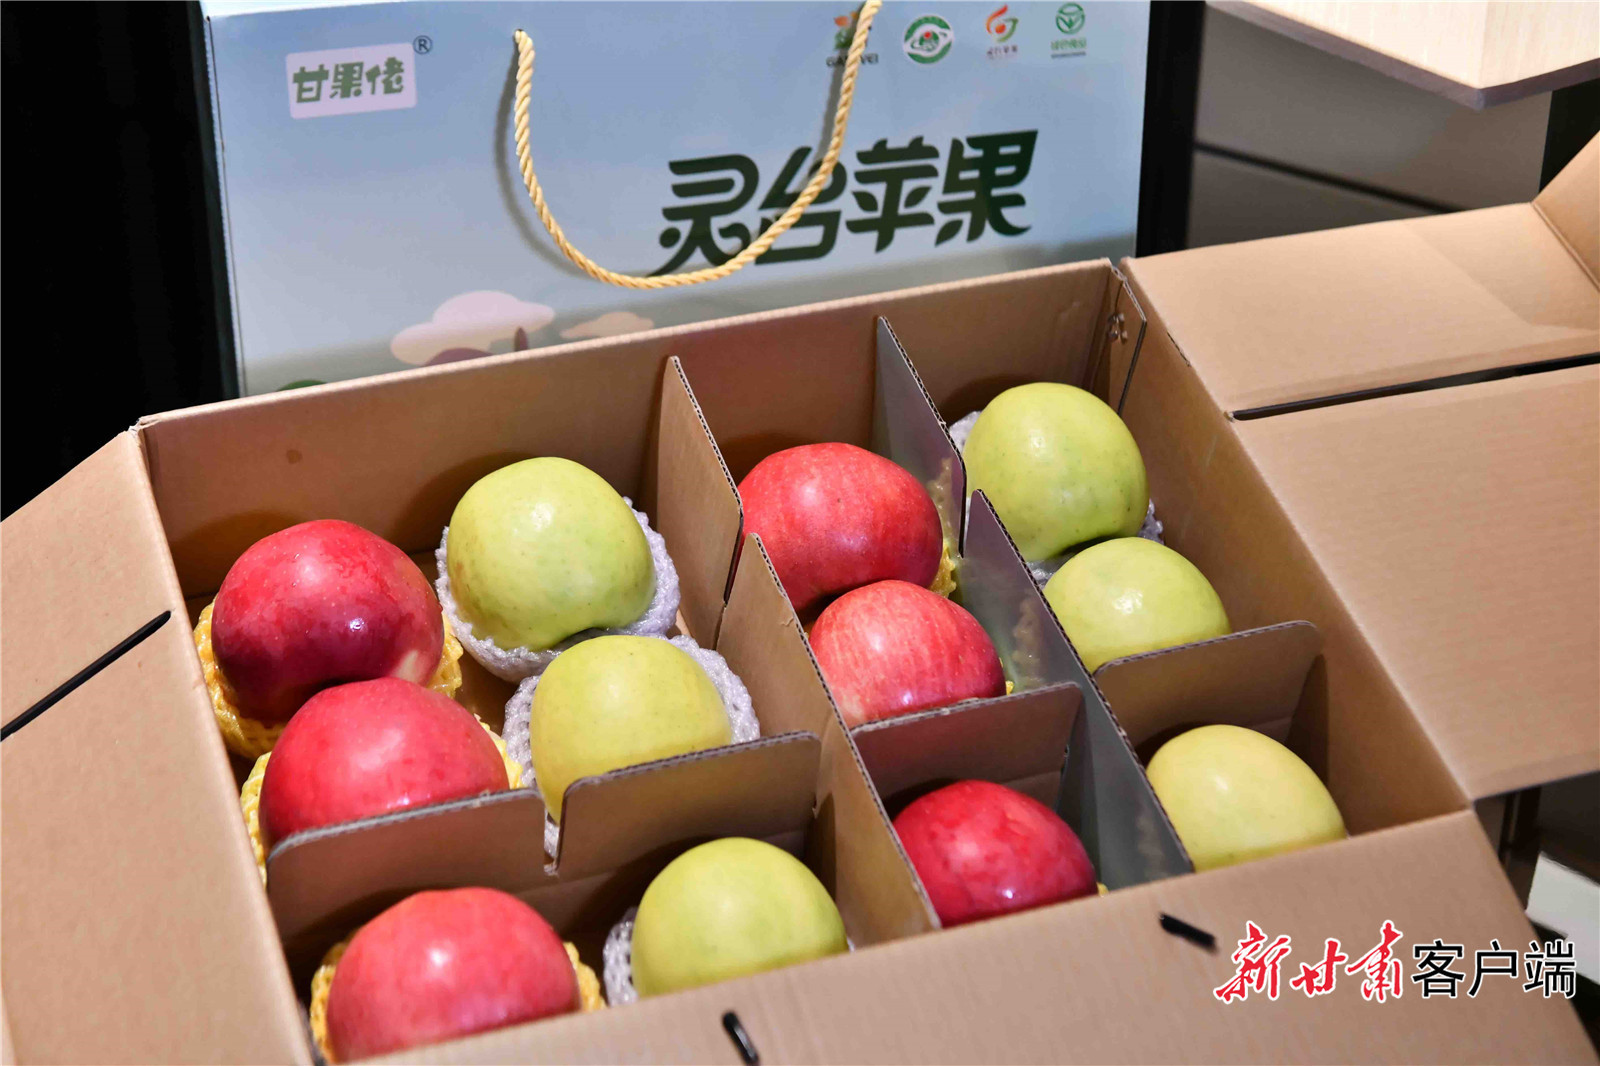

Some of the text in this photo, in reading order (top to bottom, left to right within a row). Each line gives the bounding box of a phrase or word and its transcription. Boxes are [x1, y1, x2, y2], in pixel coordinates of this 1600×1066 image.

[292, 56, 404, 103] 甘果佬
[646, 130, 1039, 277] 灵台苹果
